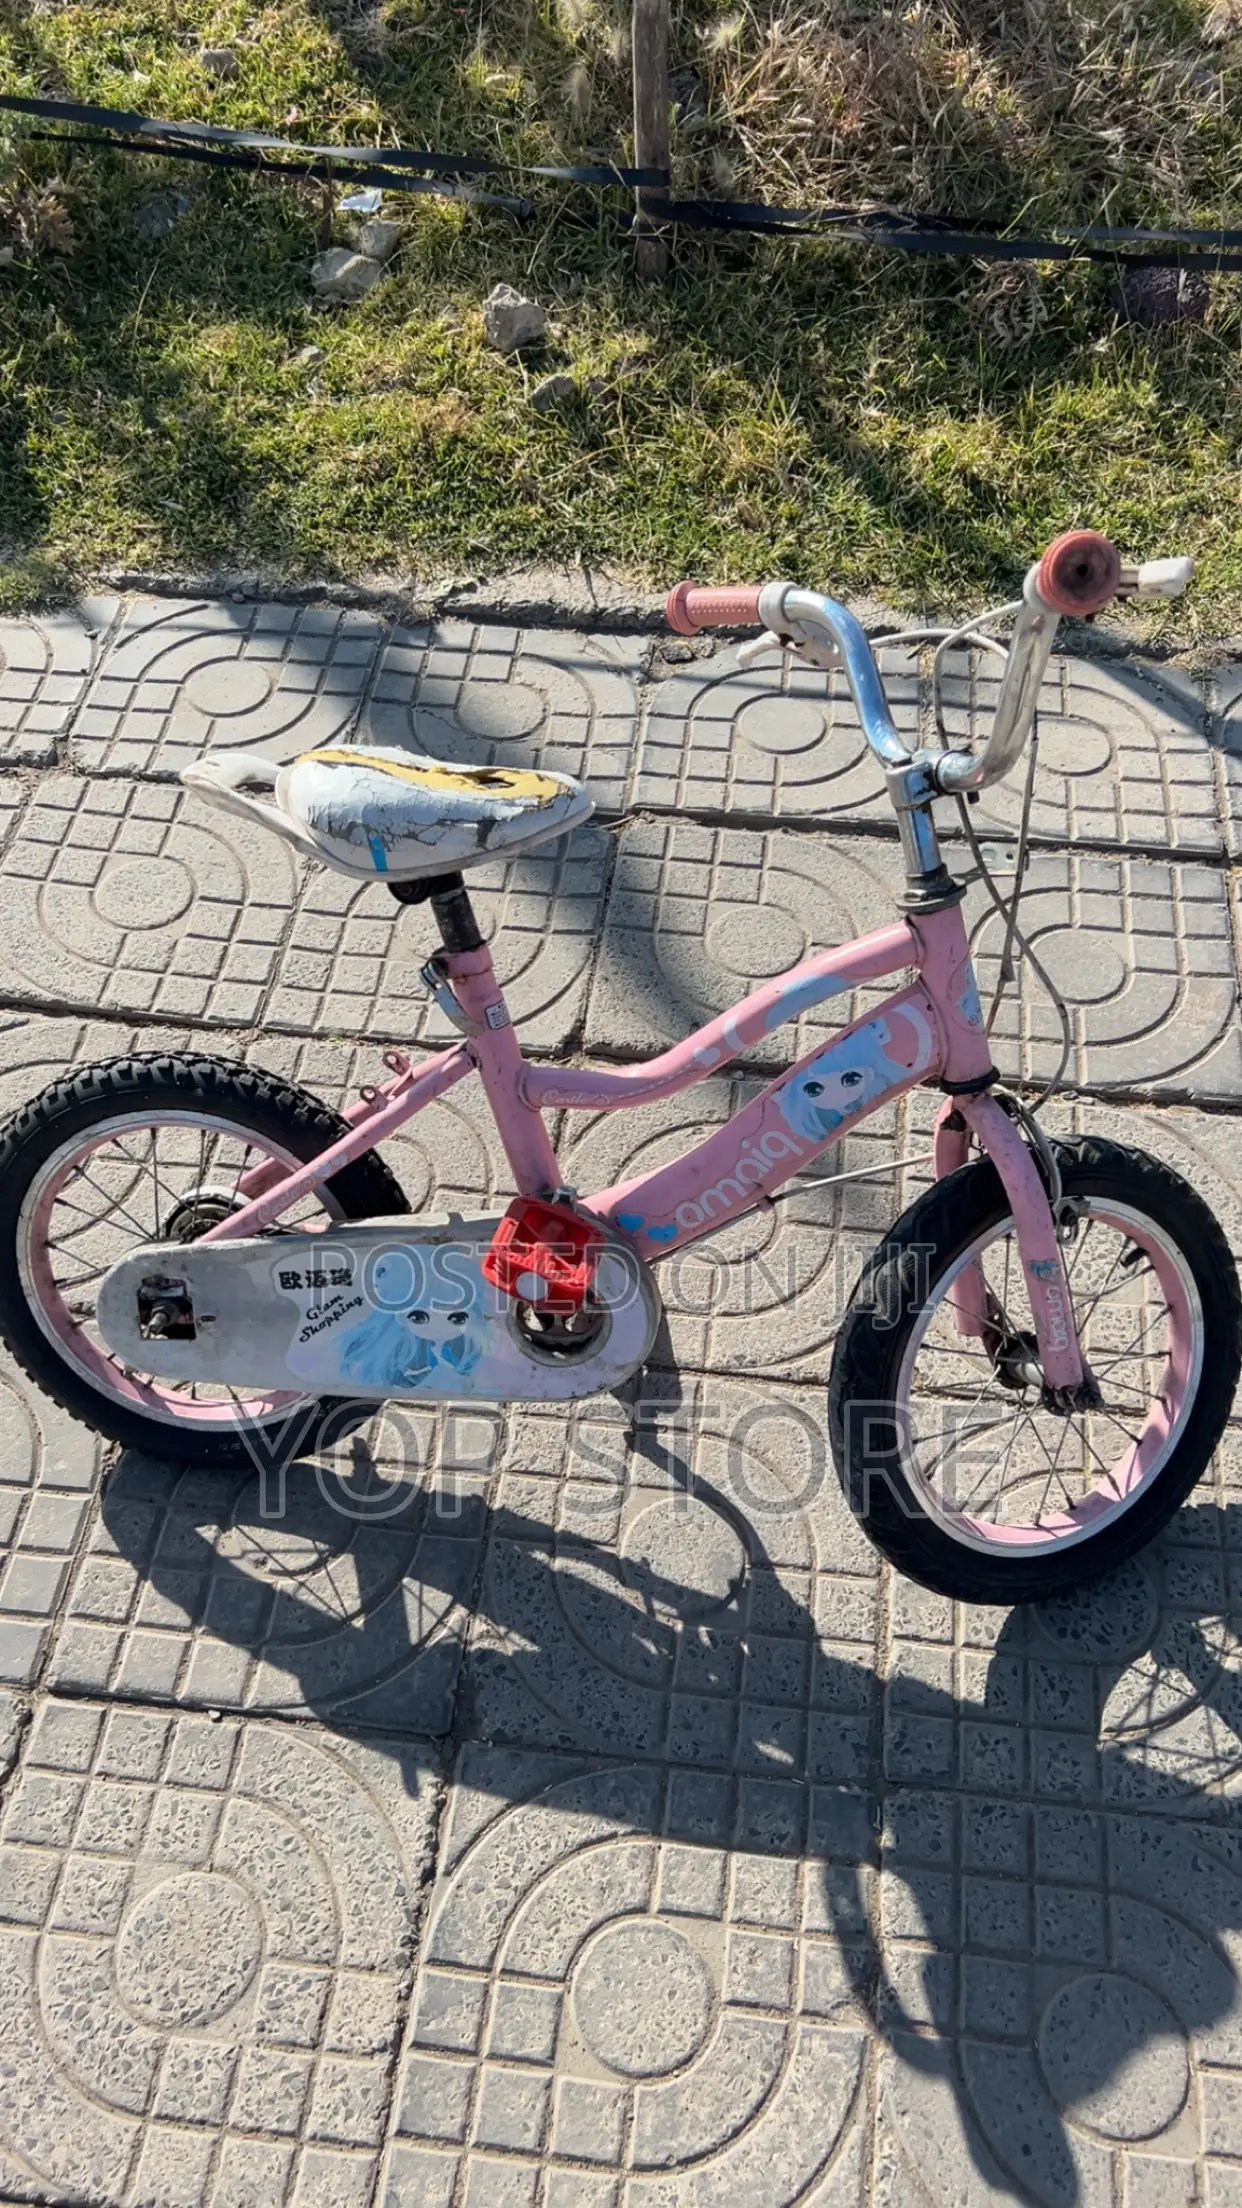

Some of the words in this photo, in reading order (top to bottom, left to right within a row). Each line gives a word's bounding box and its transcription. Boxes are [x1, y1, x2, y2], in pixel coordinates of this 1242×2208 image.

[675, 1130, 805, 1229] omaiq
[299, 1296, 363, 1343] Shopping
[306, 1295, 344, 1321] Glam
